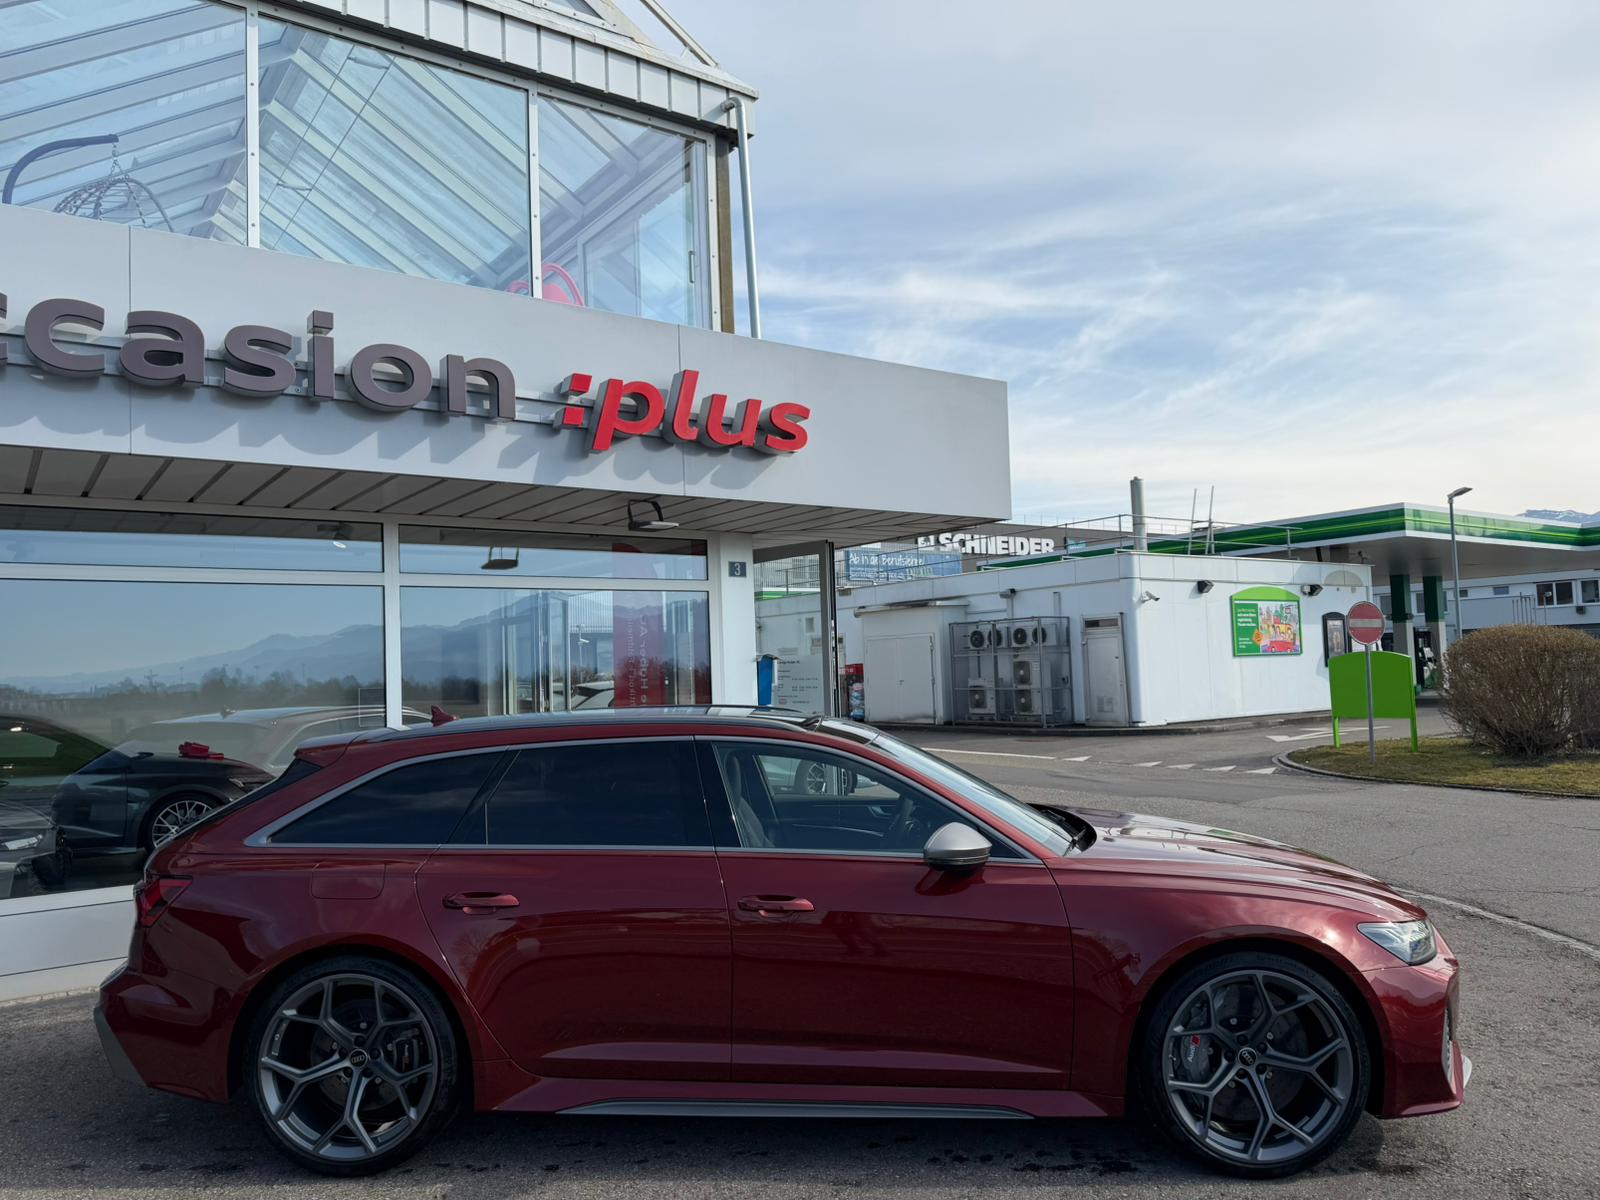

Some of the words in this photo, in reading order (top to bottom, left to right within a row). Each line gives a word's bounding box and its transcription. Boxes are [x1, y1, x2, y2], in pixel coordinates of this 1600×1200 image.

[0, 292, 516, 421] casion
[939, 532, 1055, 555] SCHNEIDER
[734, 562, 742, 577] 3
